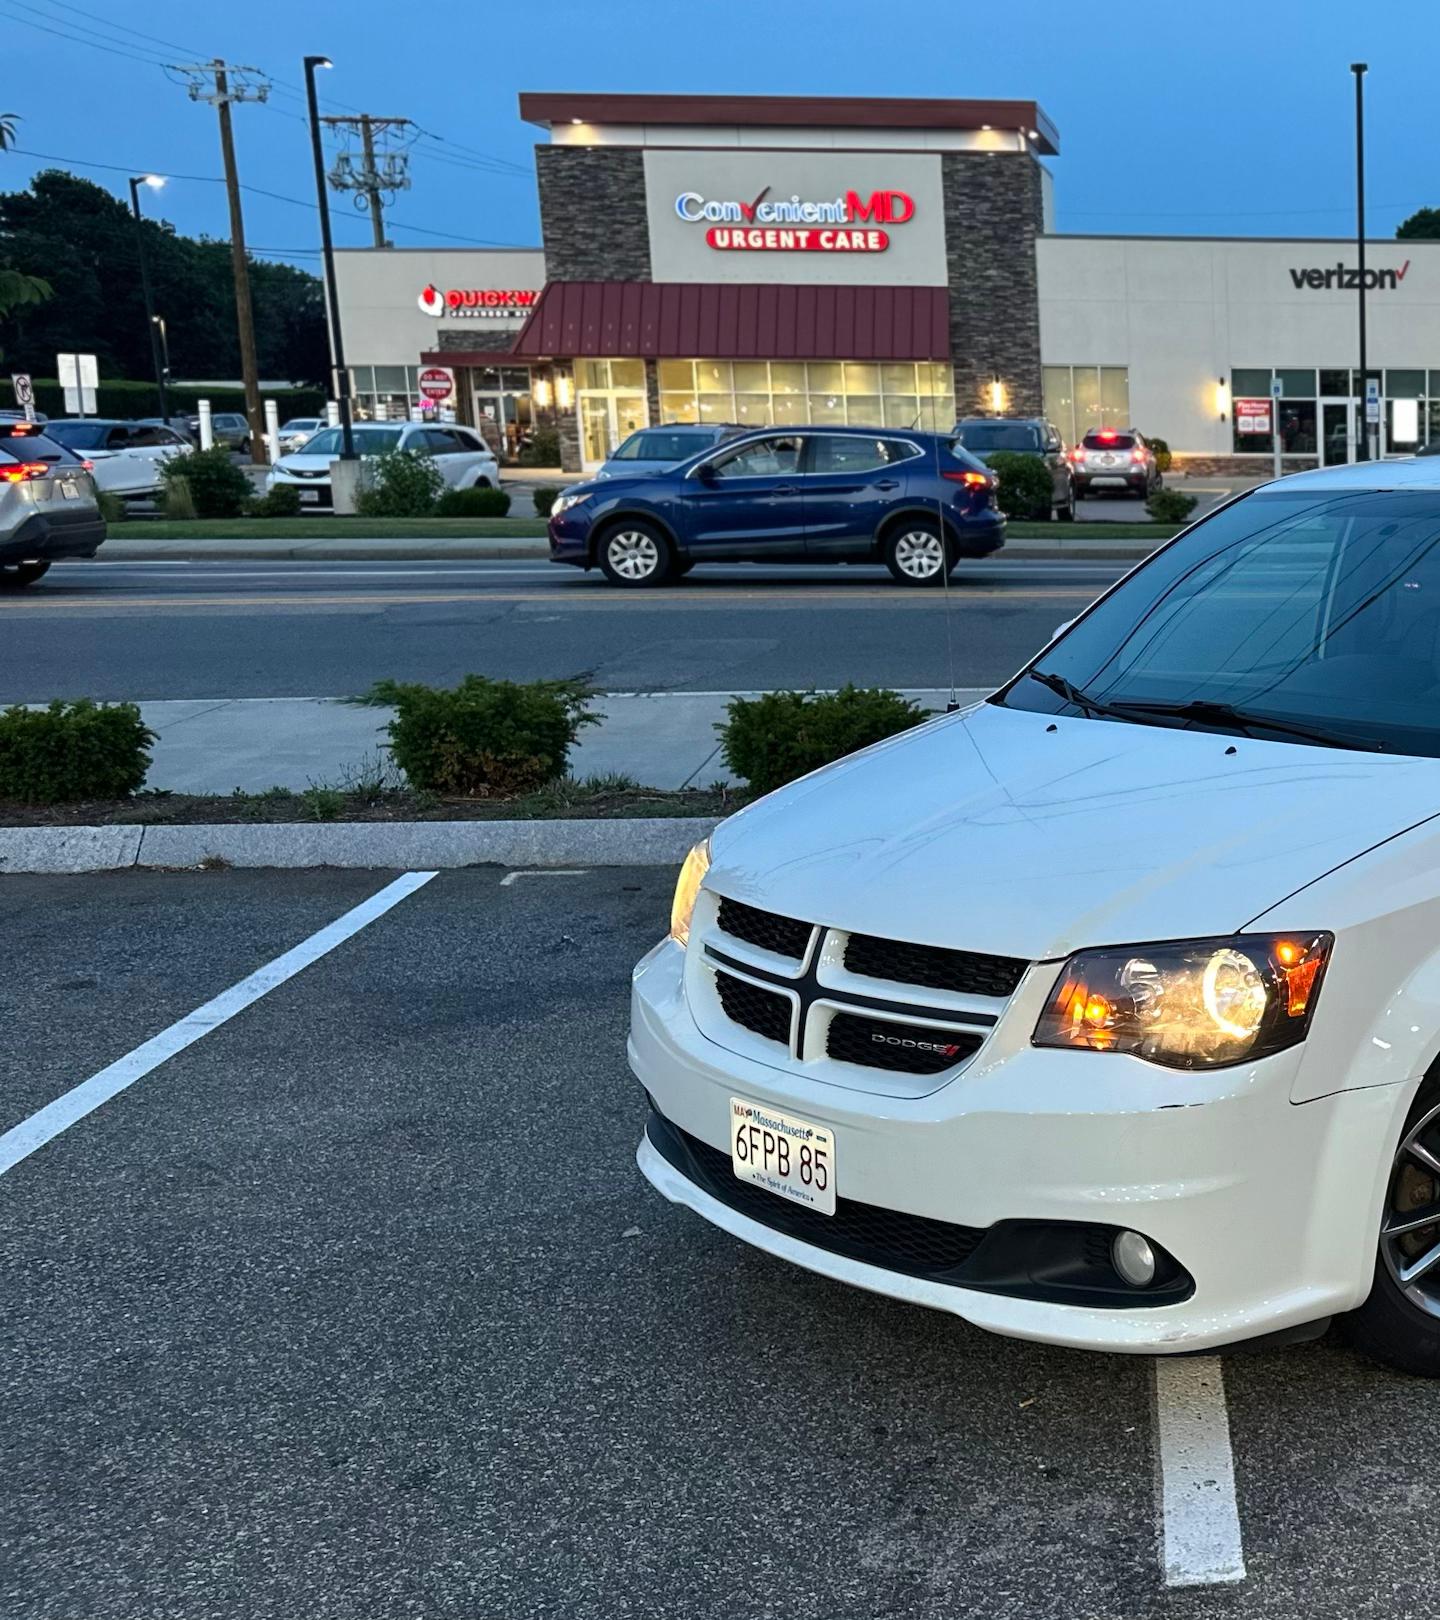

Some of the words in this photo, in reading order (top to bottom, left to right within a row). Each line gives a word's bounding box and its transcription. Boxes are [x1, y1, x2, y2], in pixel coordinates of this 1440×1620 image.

[675, 186, 915, 223] ConvenientMD
[714, 230, 809, 248] URGENT
[820, 232, 880, 249] CARE
[1289, 262, 1397, 289] verizon
[872, 1034, 946, 1053] DODGE
[753, 1110, 810, 1142] Massachusetts
[736, 1124, 791, 1177] 6FPB
[800, 1145, 828, 1191] 85
